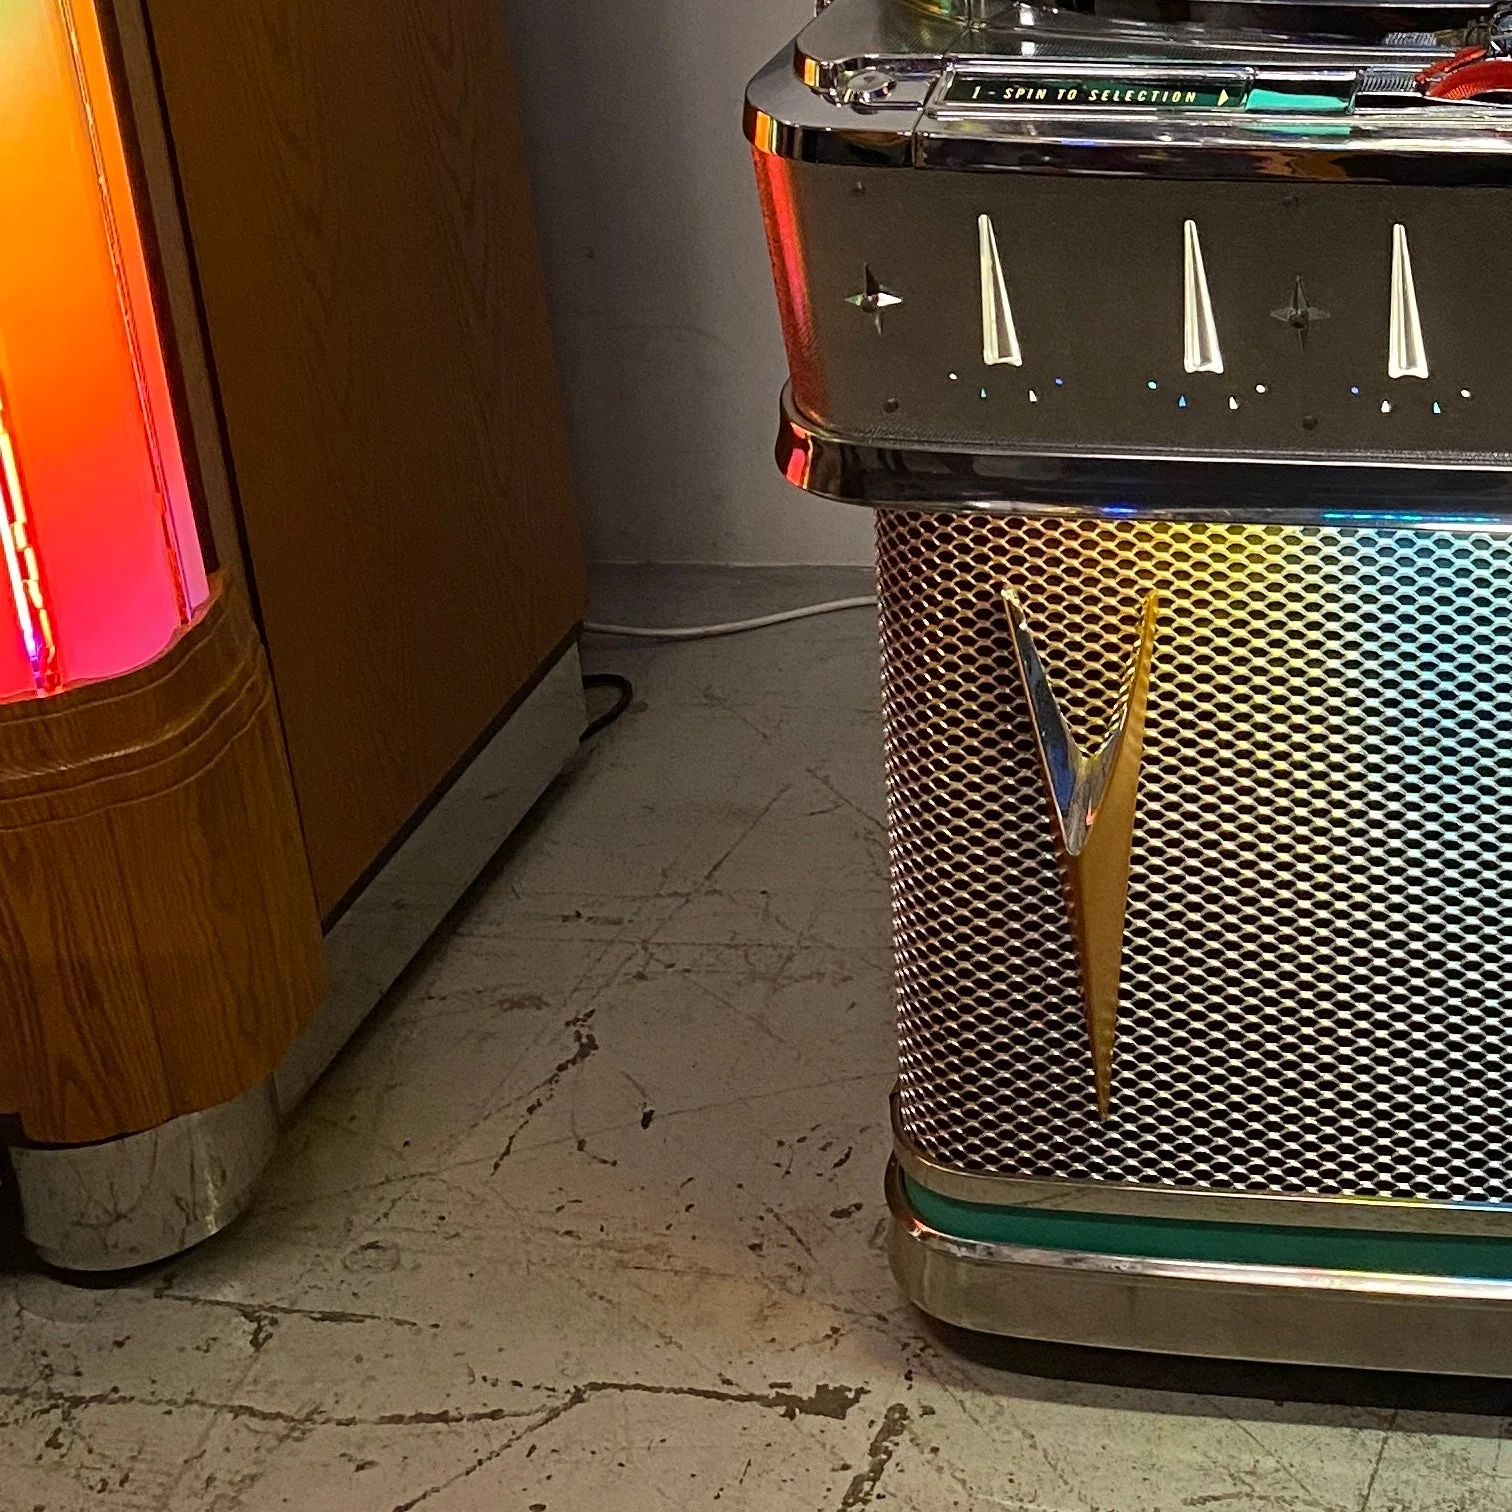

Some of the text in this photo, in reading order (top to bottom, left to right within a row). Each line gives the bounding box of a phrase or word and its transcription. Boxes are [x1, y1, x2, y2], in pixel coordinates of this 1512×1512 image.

[1003, 88, 1047, 100] SPIN
[1057, 88, 1077, 100] TO
[1088, 89, 1197, 103] SELECTION
